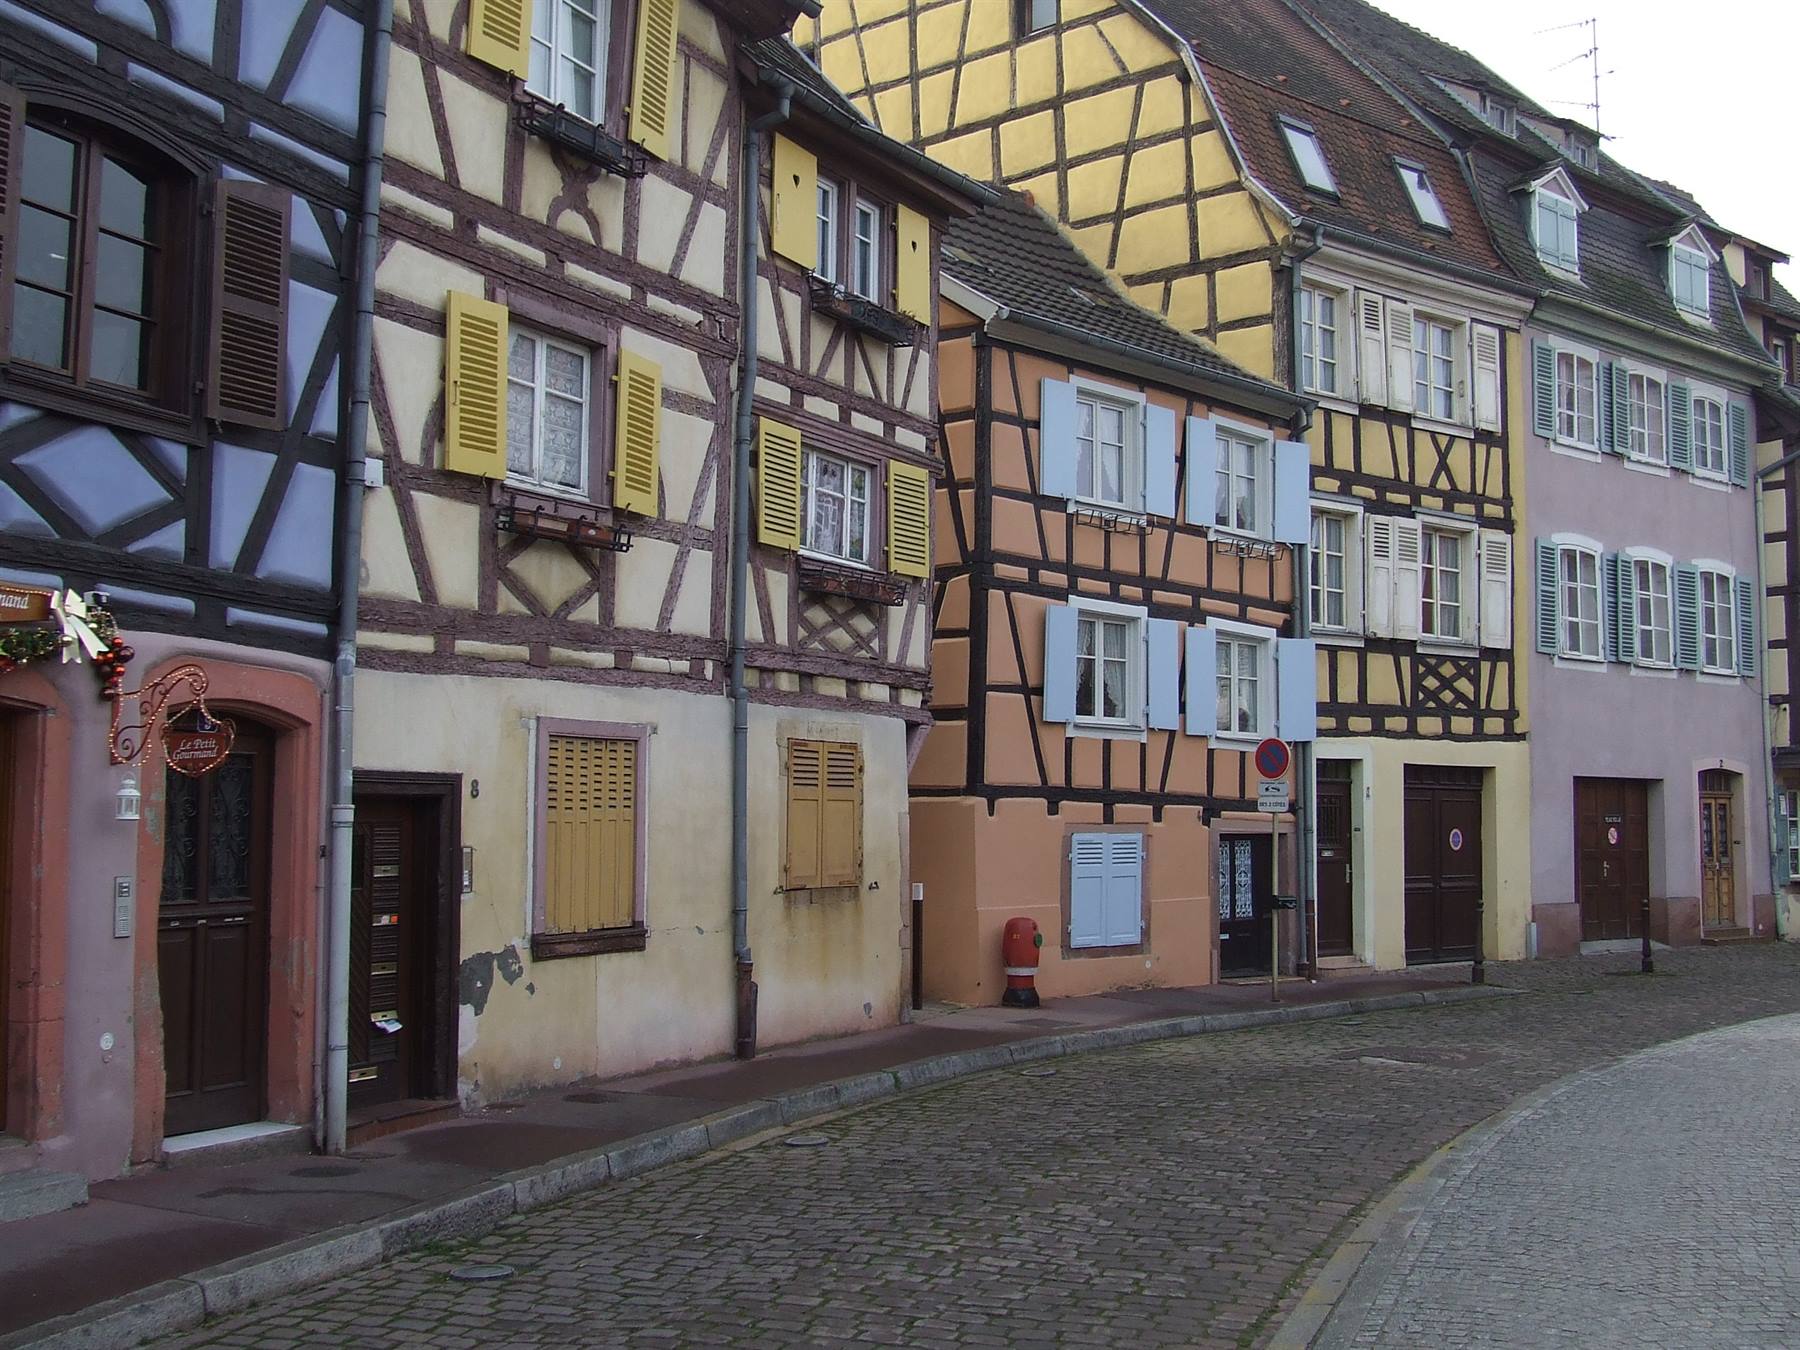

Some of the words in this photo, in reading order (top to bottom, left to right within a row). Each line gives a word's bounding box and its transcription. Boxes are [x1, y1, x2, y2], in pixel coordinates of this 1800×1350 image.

[180, 739, 192, 750] Le
[193, 738, 216, 749] Petit
[173, 746, 219, 763] Gourmand
[470, 778, 480, 799] 8
